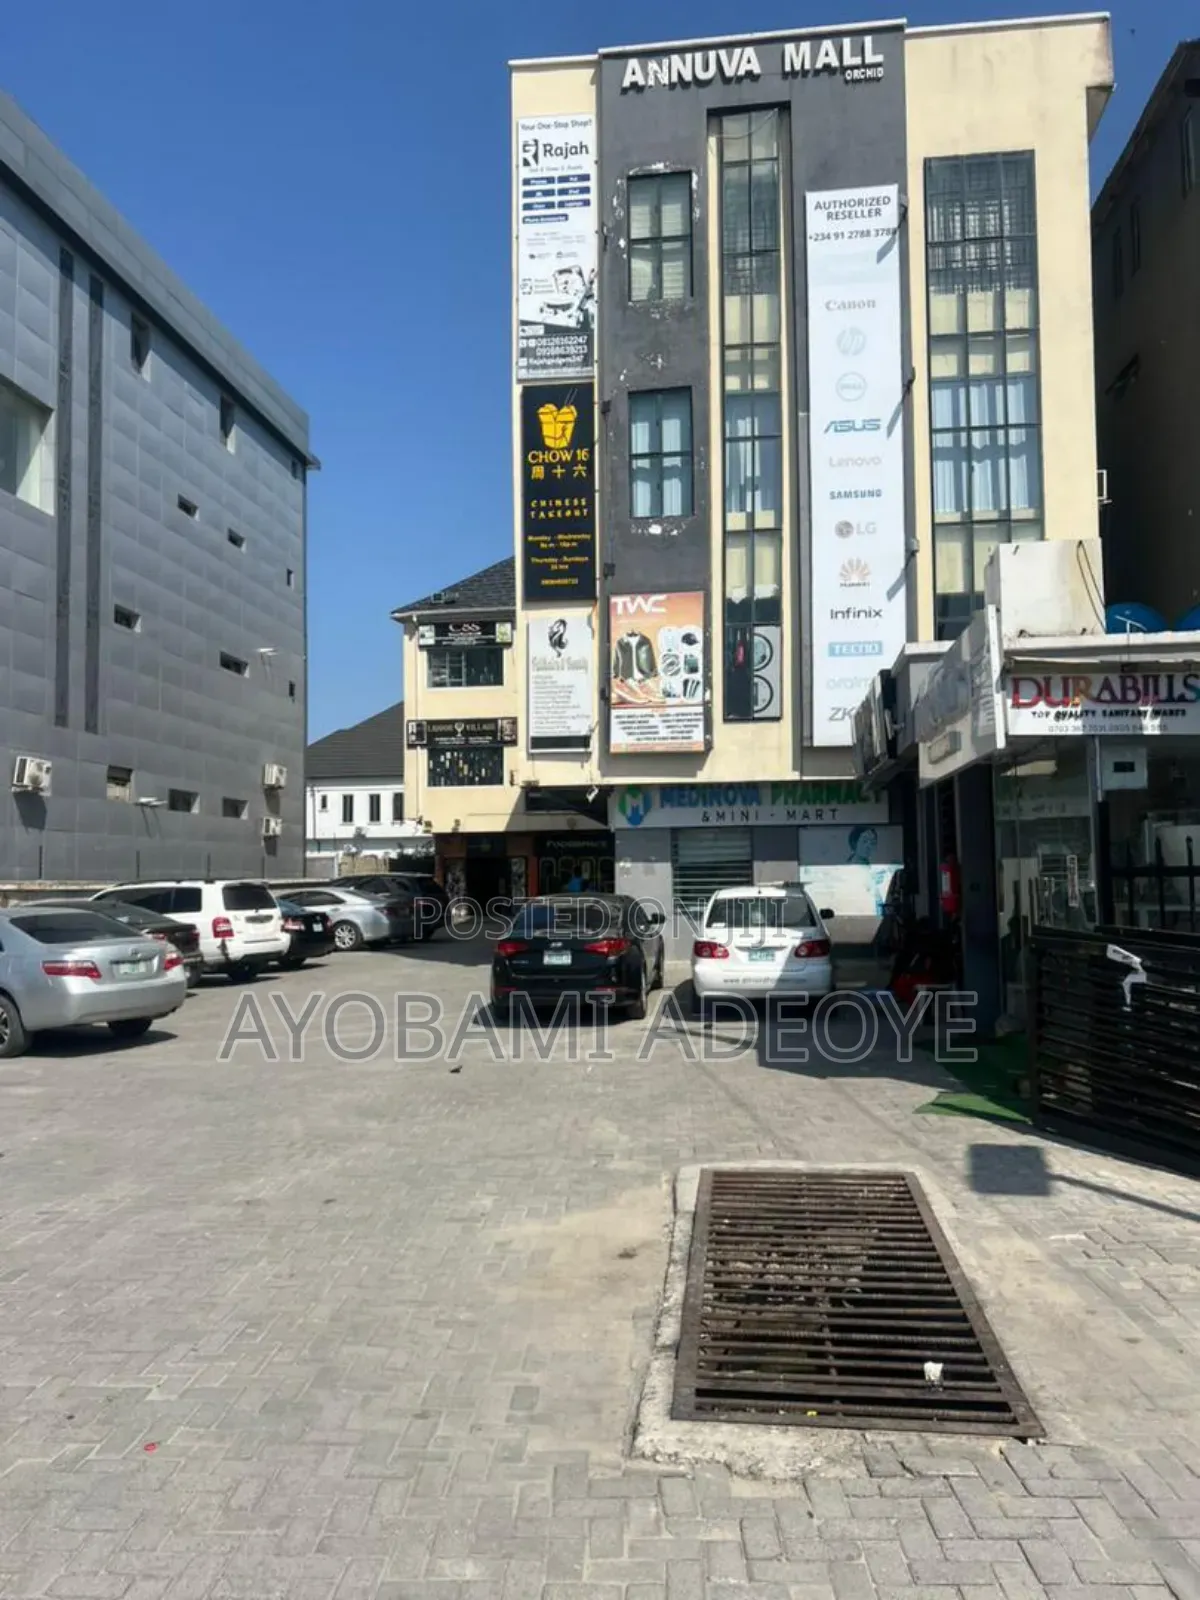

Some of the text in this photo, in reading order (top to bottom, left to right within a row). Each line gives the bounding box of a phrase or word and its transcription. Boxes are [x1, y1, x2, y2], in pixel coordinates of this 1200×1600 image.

[621, 35, 884, 88] ANNUVA MALL
[845, 67, 884, 81] ORCHID
[543, 141, 589, 160] Rajah
[814, 195, 891, 211] AUTHORIZED
[826, 207, 882, 221] RESELLER
[824, 299, 876, 311] Canon
[824, 418, 881, 434] ASUS
[528, 448, 590, 464] CHOW 16
[829, 455, 882, 467] Lenovo
[829, 488, 882, 500] SAMSUNG
[856, 522, 876, 535] LG
[611, 594, 666, 615] TWC
[830, 606, 883, 620] Infinix
[1011, 673, 1200, 709] DURABILLS
[1053, 709, 1096, 722] QUALITY
[659, 785, 760, 808] MEDINOVA
[786, 808, 840, 821] MART
